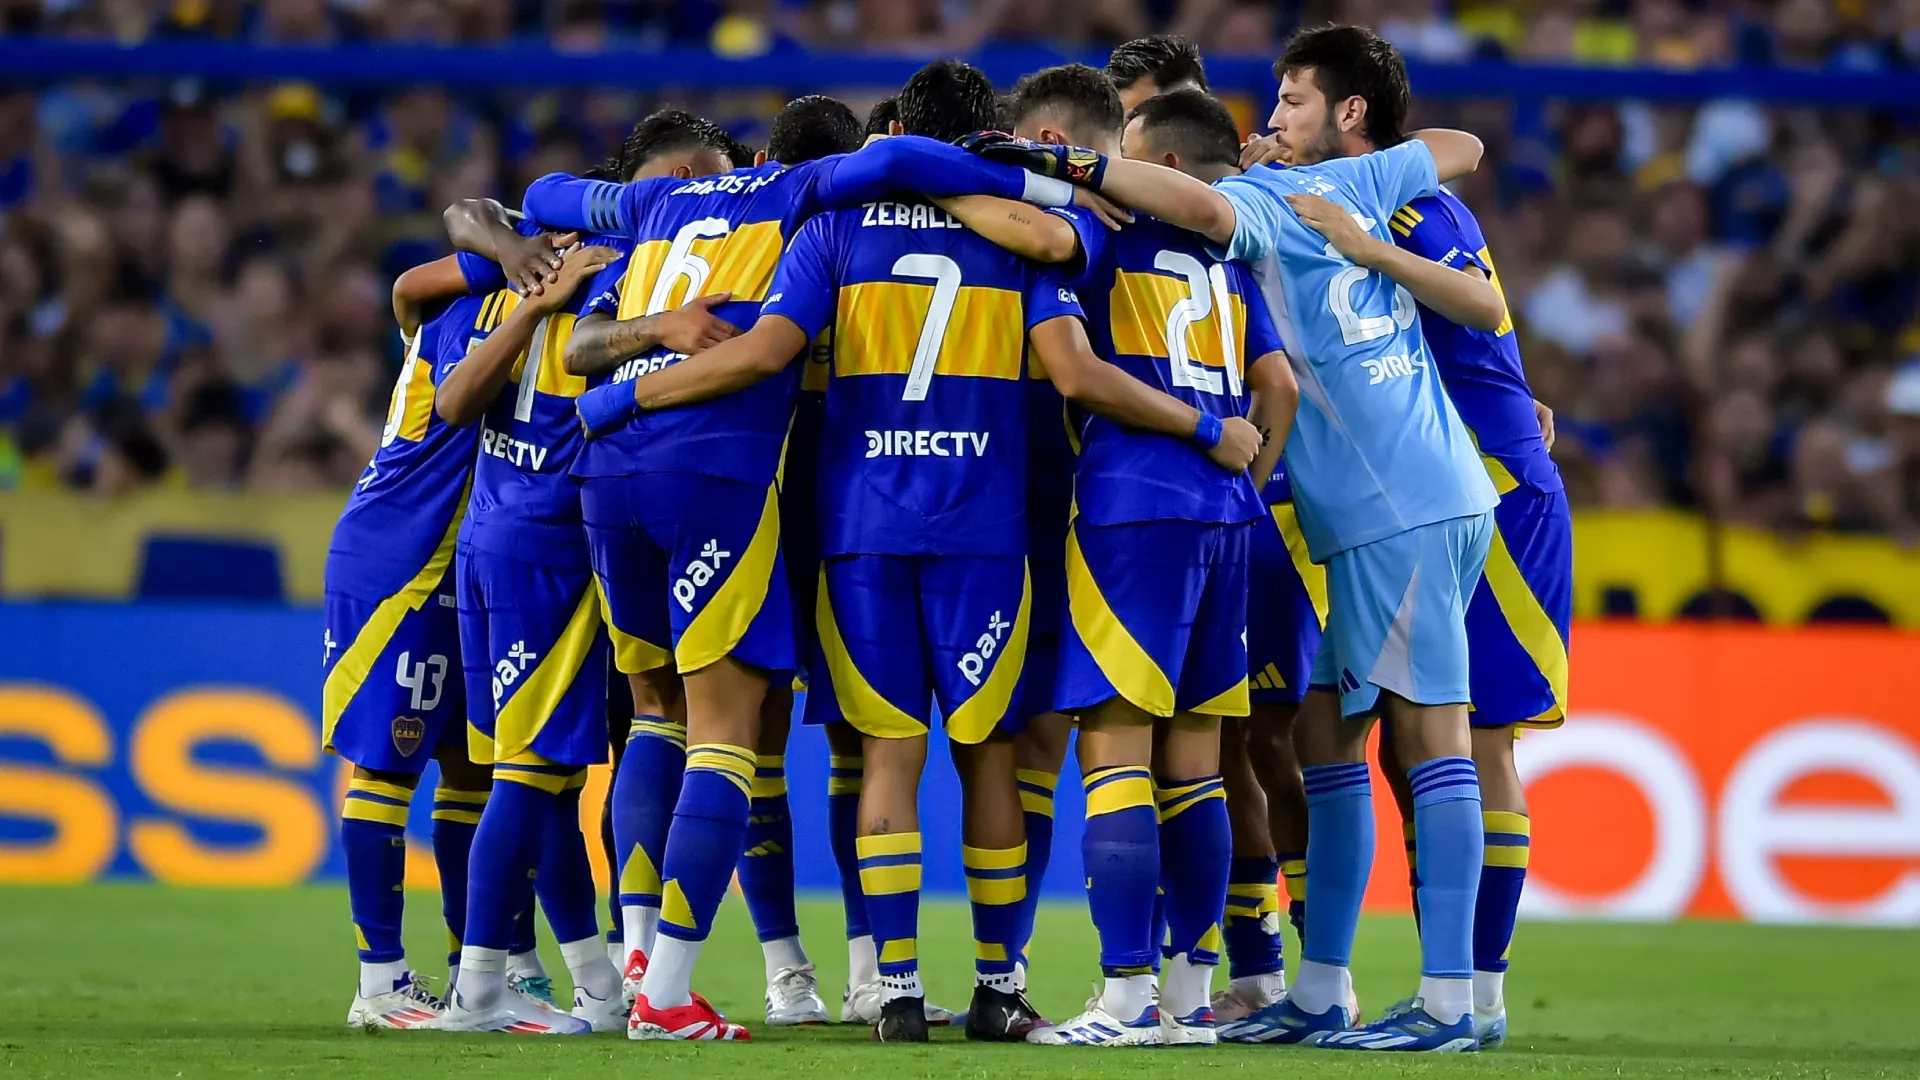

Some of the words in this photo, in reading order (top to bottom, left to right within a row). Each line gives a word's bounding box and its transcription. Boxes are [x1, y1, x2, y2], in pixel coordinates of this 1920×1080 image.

[862, 202, 970, 229] ZEBALL
[645, 216, 730, 318] 6
[891, 253, 962, 401] 7
[1153, 249, 1243, 397] 21
[612, 352, 691, 385] DIREC
[864, 430, 990, 459] DIRECTV
[673, 538, 731, 614] pax
[396, 651, 448, 711] 43
[492, 640, 537, 710] pax
[957, 610, 1011, 687] pax
